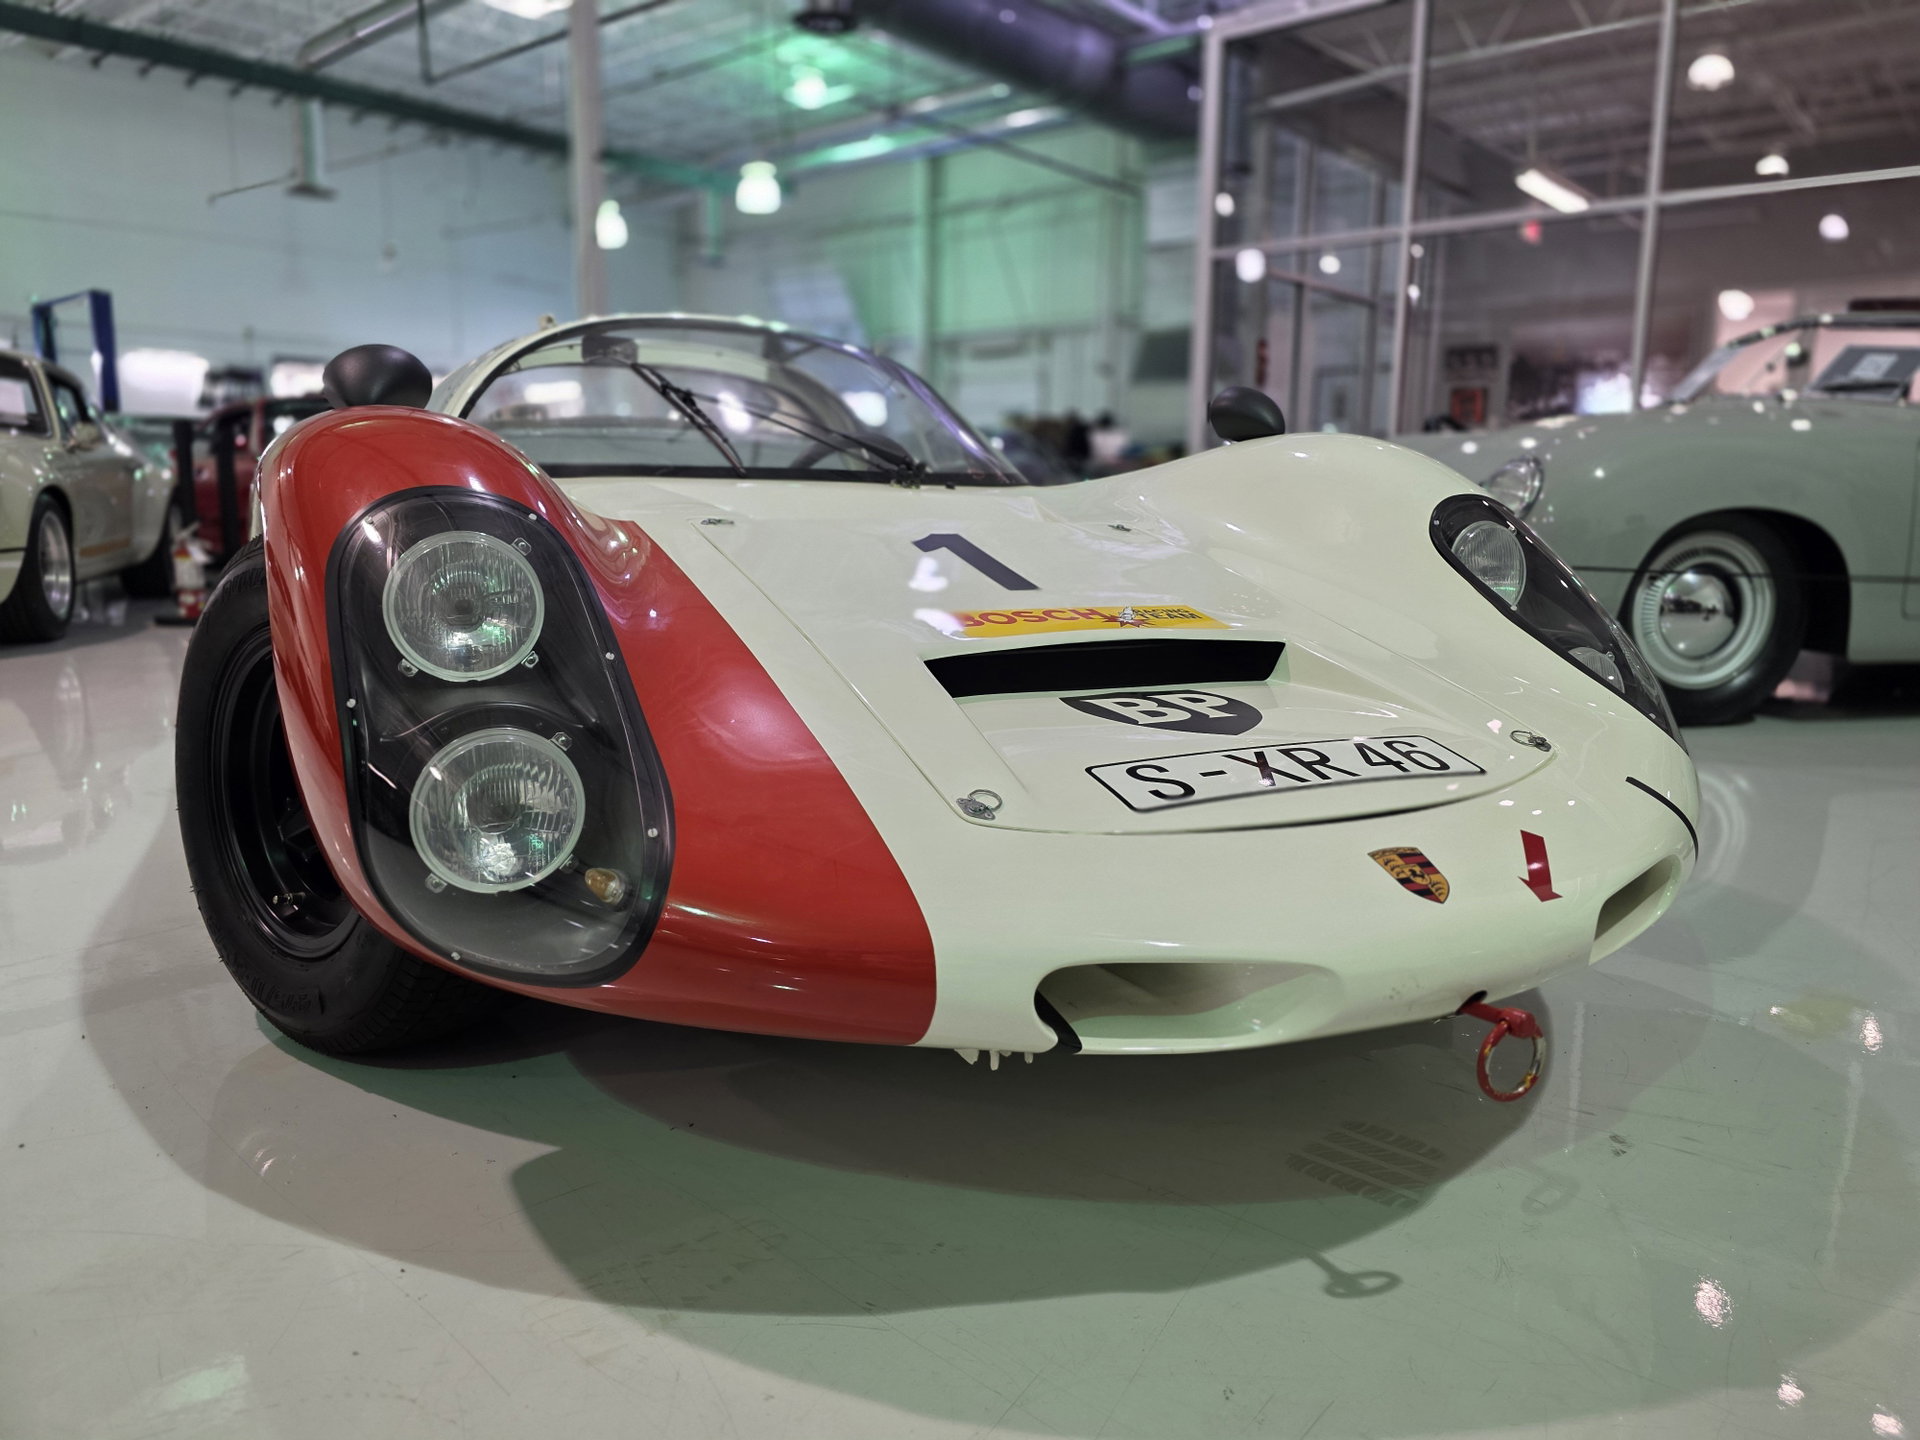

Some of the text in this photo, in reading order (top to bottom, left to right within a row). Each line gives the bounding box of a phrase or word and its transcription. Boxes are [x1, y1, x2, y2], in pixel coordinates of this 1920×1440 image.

[911, 533, 1041, 591] 1
[1080, 694, 1237, 724] BP
[1353, 740, 1450, 773] 46
